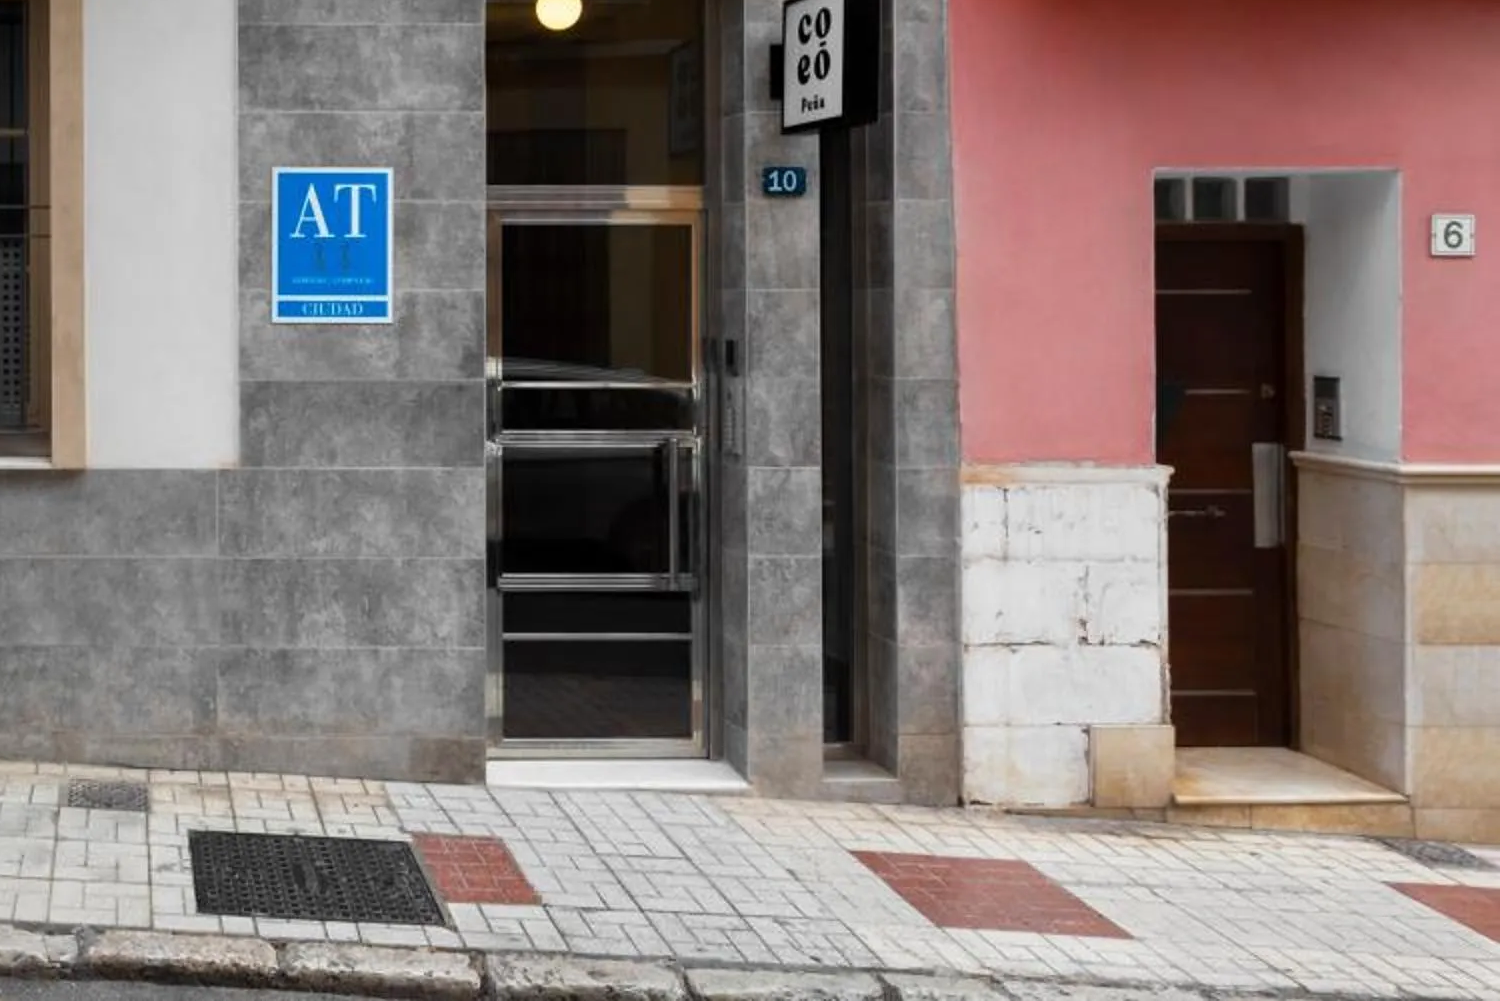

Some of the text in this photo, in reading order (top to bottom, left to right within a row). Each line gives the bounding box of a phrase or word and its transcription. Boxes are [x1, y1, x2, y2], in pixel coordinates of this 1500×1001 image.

[768, 170, 797, 192] 10
[290, 182, 377, 238] AT
[1444, 221, 1463, 249] 6
[302, 302, 363, 315] CIUDAD
